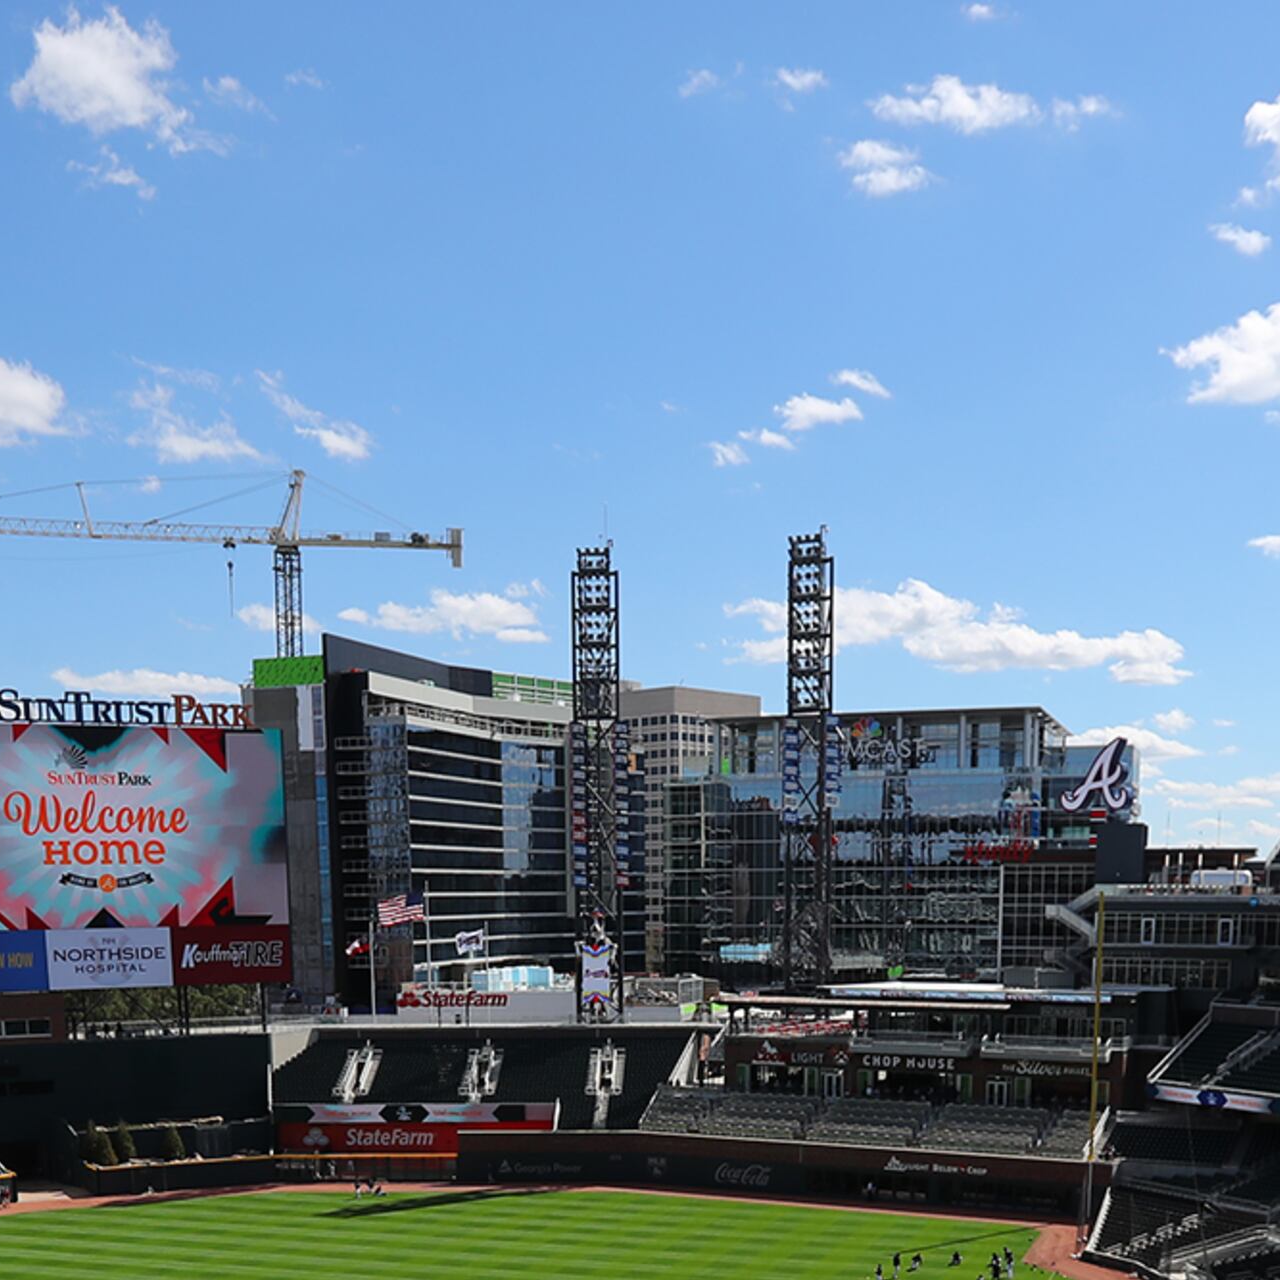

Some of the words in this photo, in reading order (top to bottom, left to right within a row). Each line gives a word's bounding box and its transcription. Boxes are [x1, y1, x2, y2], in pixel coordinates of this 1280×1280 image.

[3, 790, 189, 836] Welcome
[8, 953, 35, 968] HOW
[53, 946, 167, 962] NORTHSIDE
[75, 962, 147, 975] HOSPITAL
[862, 1056, 901, 1067] CHOP
